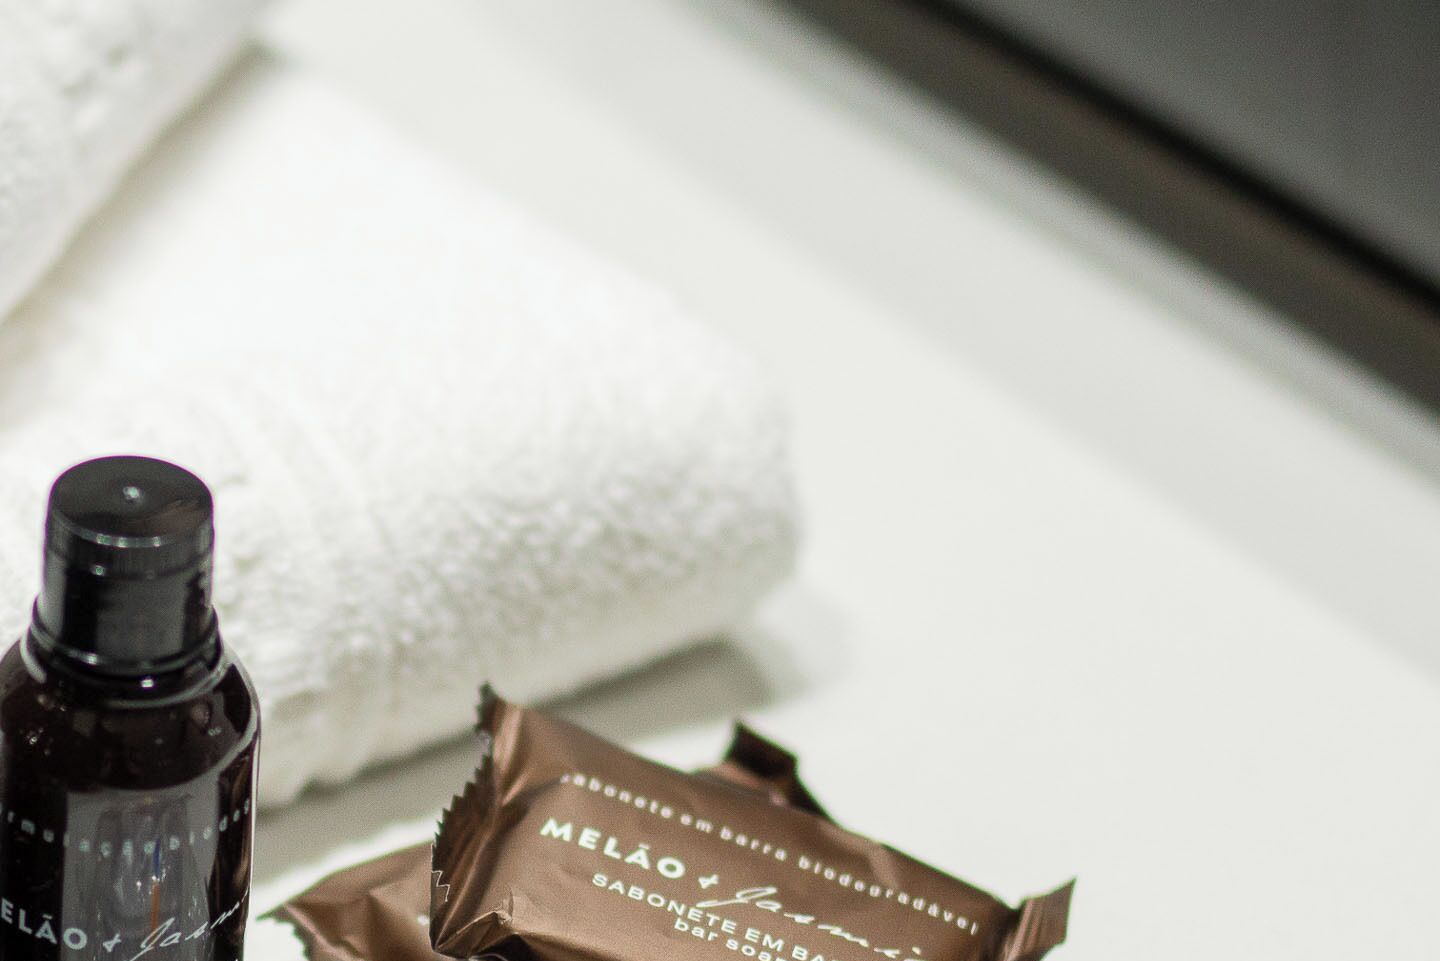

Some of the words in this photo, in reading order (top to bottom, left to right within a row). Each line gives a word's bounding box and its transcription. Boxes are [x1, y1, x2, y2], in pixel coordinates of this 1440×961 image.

[540, 817, 686, 879] MELÃO
[680, 813, 712, 833] em
[720, 827, 787, 862] barra
[798, 855, 978, 936] biodegradável
[591, 872, 738, 935] SABONETE
[745, 927, 785, 952] EM
[674, 916, 718, 941] bar
